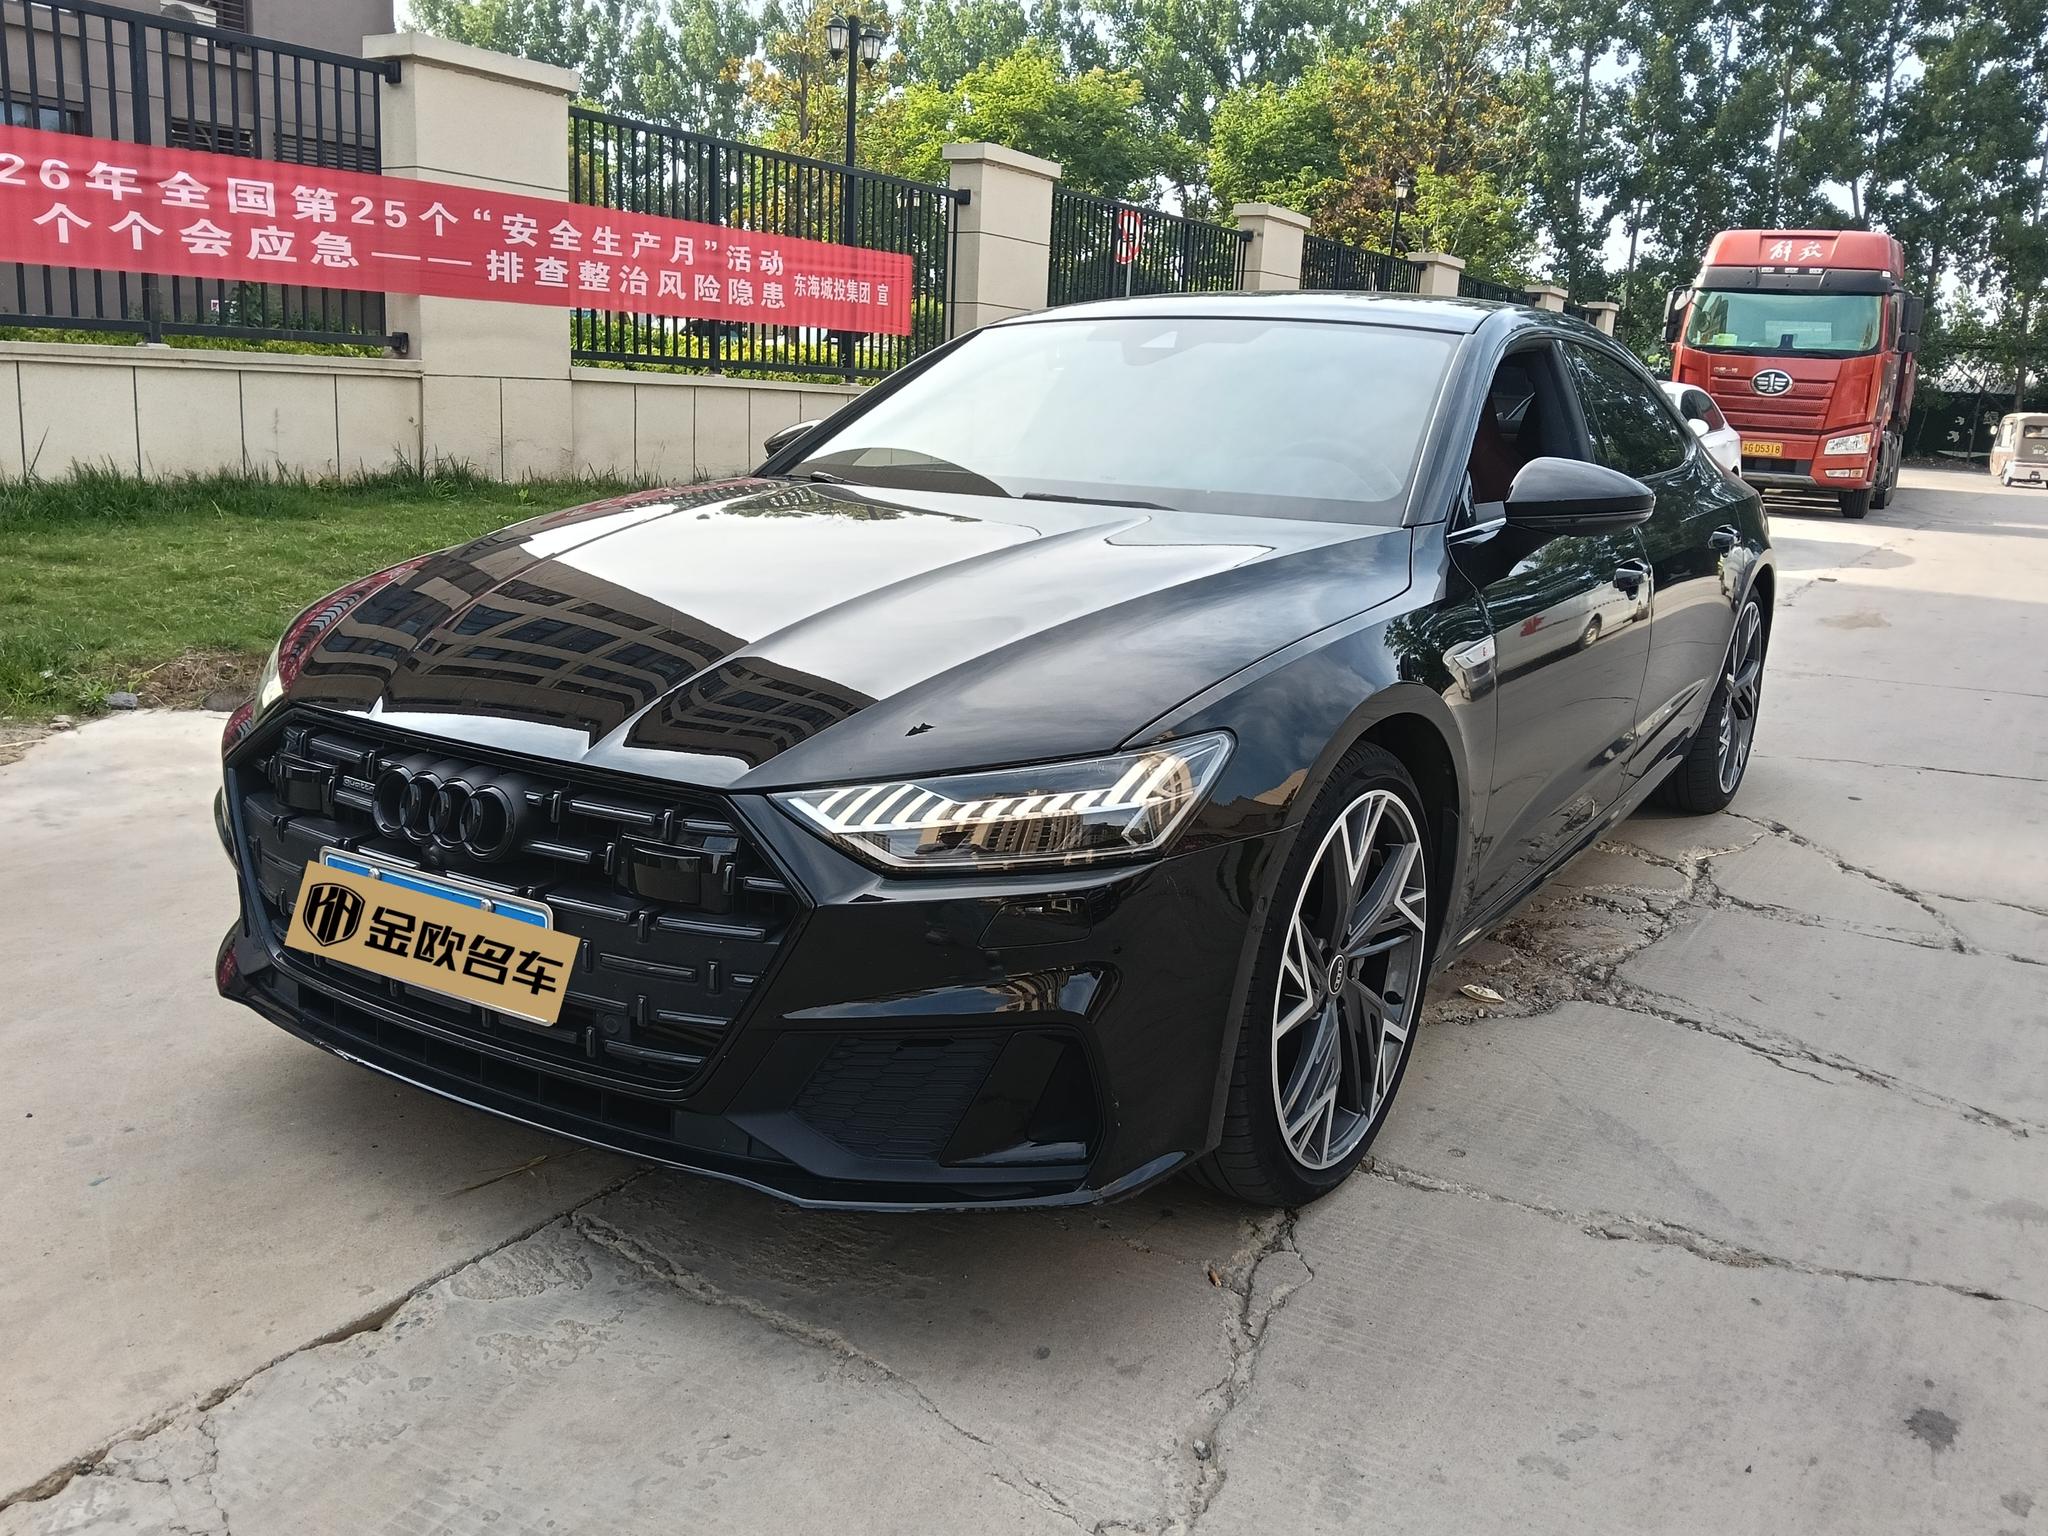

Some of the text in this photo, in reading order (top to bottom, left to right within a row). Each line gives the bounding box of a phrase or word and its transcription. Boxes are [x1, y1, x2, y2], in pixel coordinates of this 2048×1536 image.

[793, 272, 889, 306] 东海城投集团 宣
